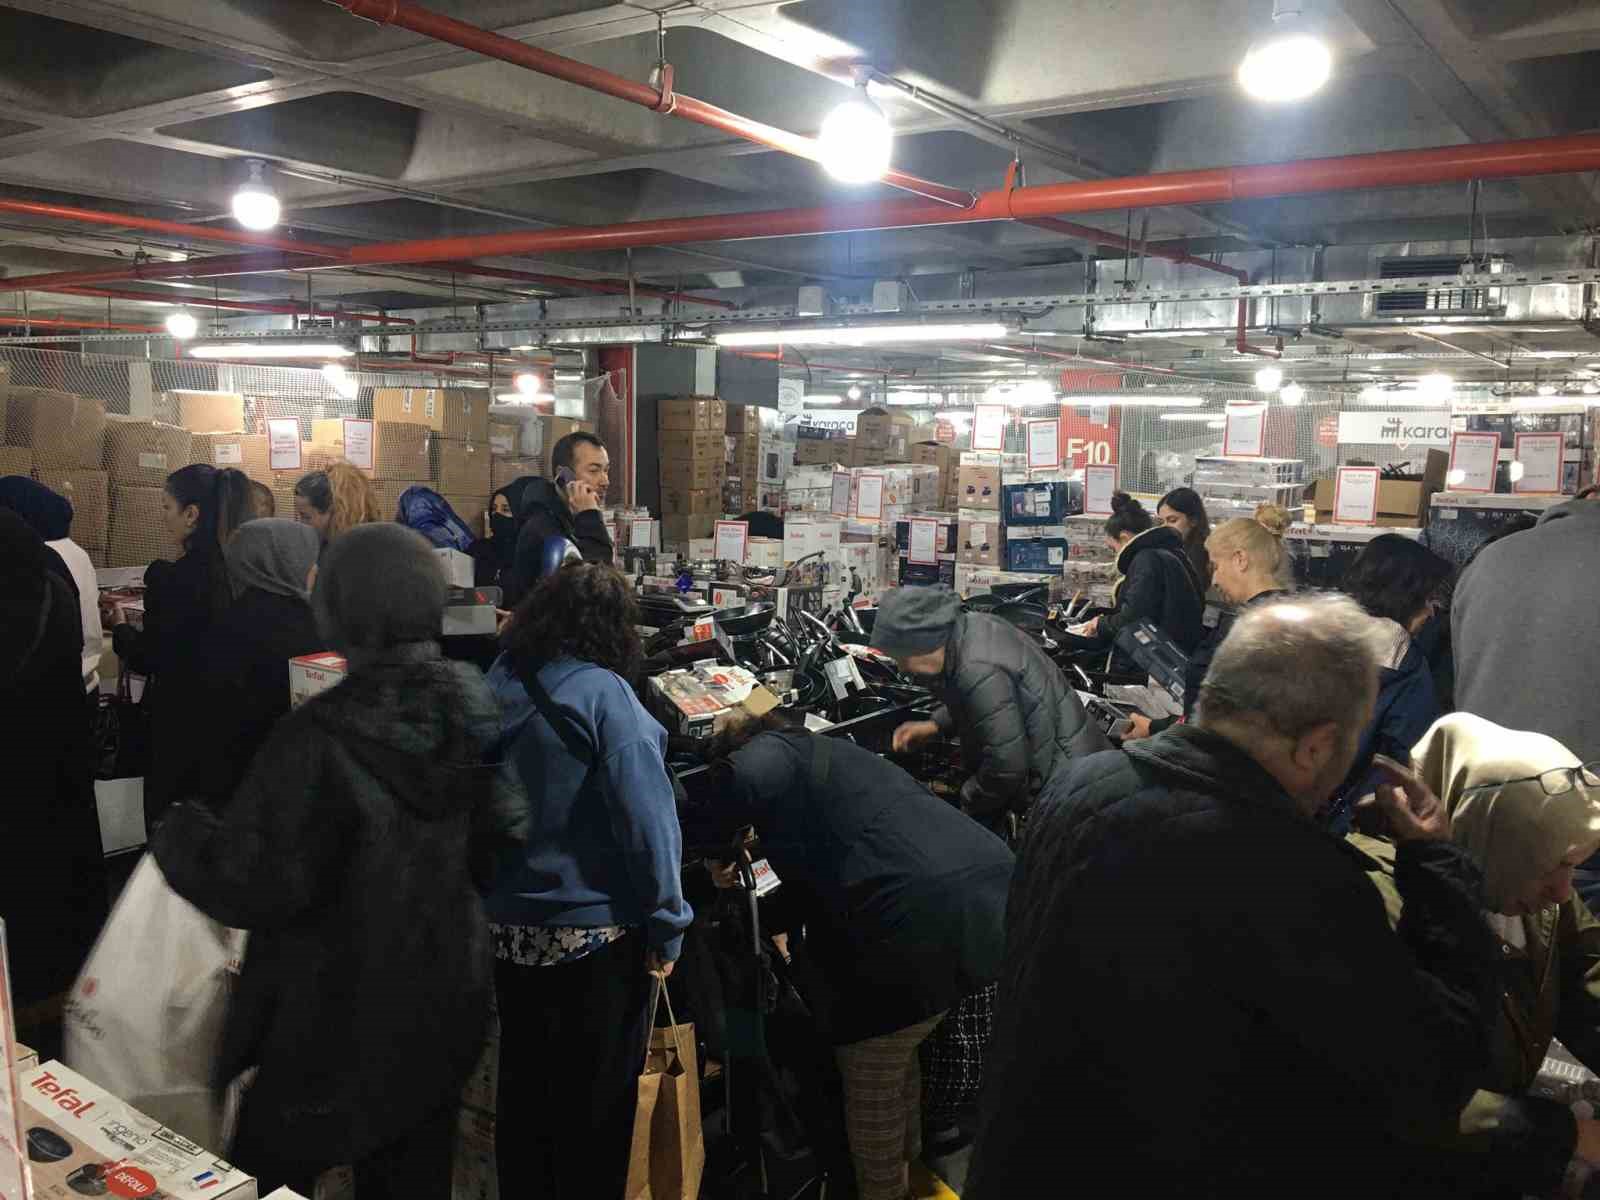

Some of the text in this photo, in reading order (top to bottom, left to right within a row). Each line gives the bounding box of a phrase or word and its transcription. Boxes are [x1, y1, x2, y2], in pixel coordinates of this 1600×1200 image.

[1403, 427, 1450, 439] kara
[1067, 438, 1110, 465] F10
[31, 1071, 95, 1119] Tefal
